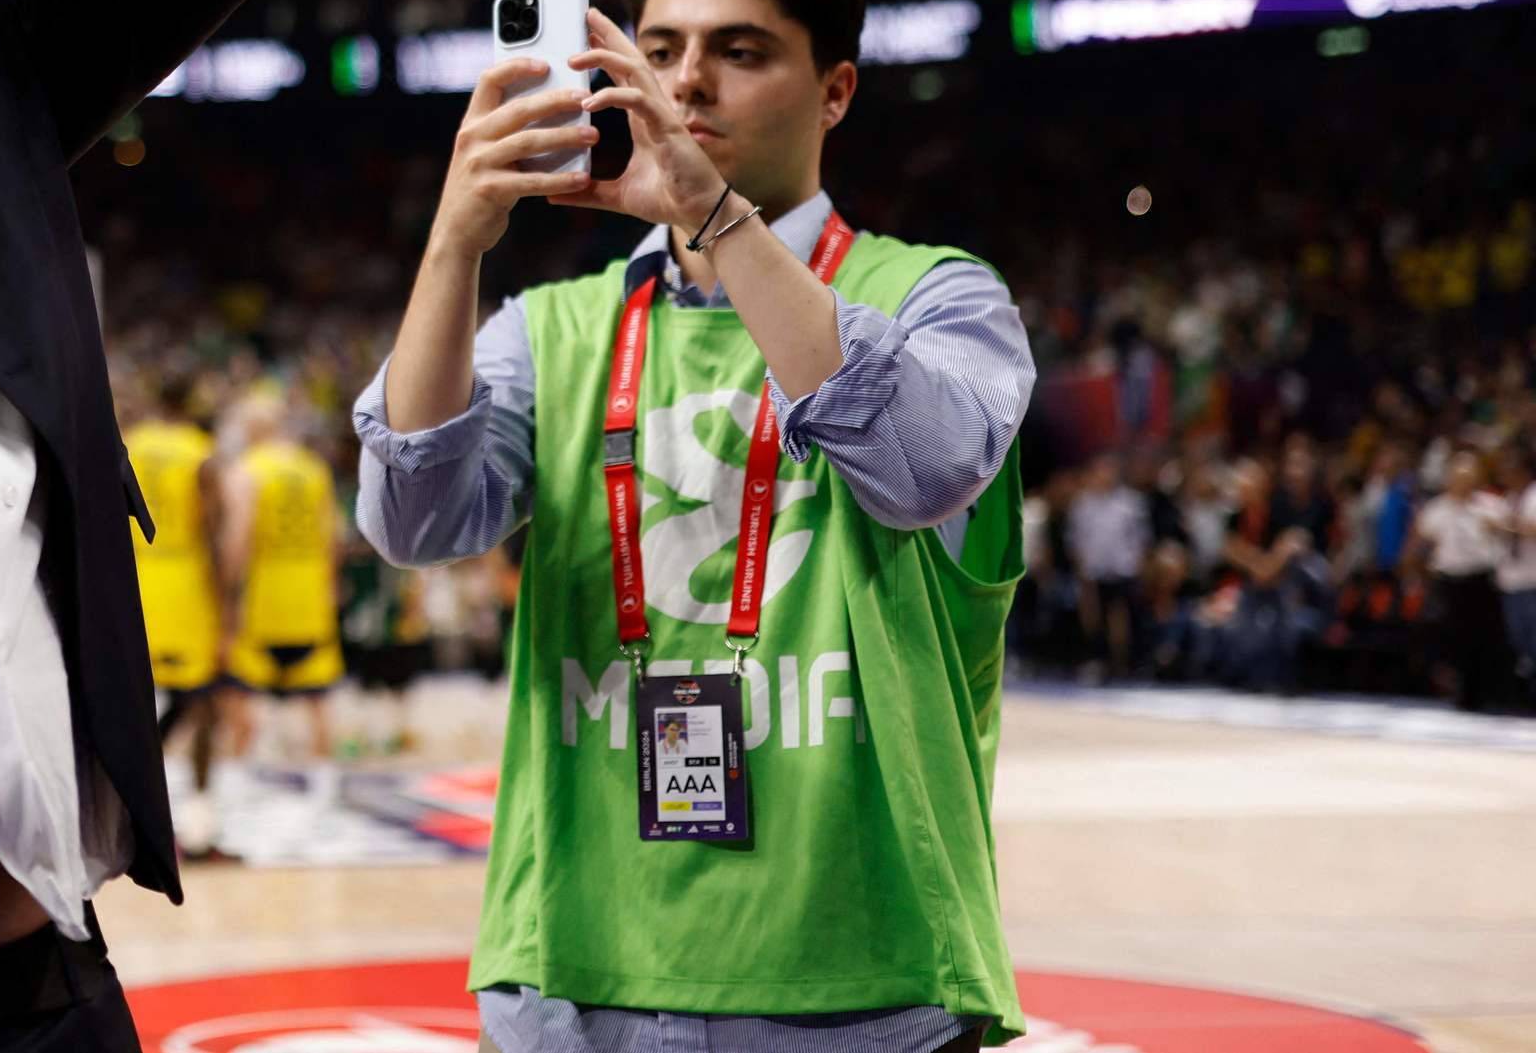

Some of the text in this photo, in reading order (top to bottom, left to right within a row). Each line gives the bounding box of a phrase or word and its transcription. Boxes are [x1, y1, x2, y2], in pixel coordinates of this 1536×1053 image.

[619, 308, 642, 389] TURKISH AIRLINES
[615, 484, 633, 587] TURKISH AIRLINES
[740, 506, 761, 611] TURKISH AIRLINES
[561, 651, 865, 750] MDIA
[641, 731, 652, 792] BERLIN 2024
[666, 774, 717, 794] AAA
